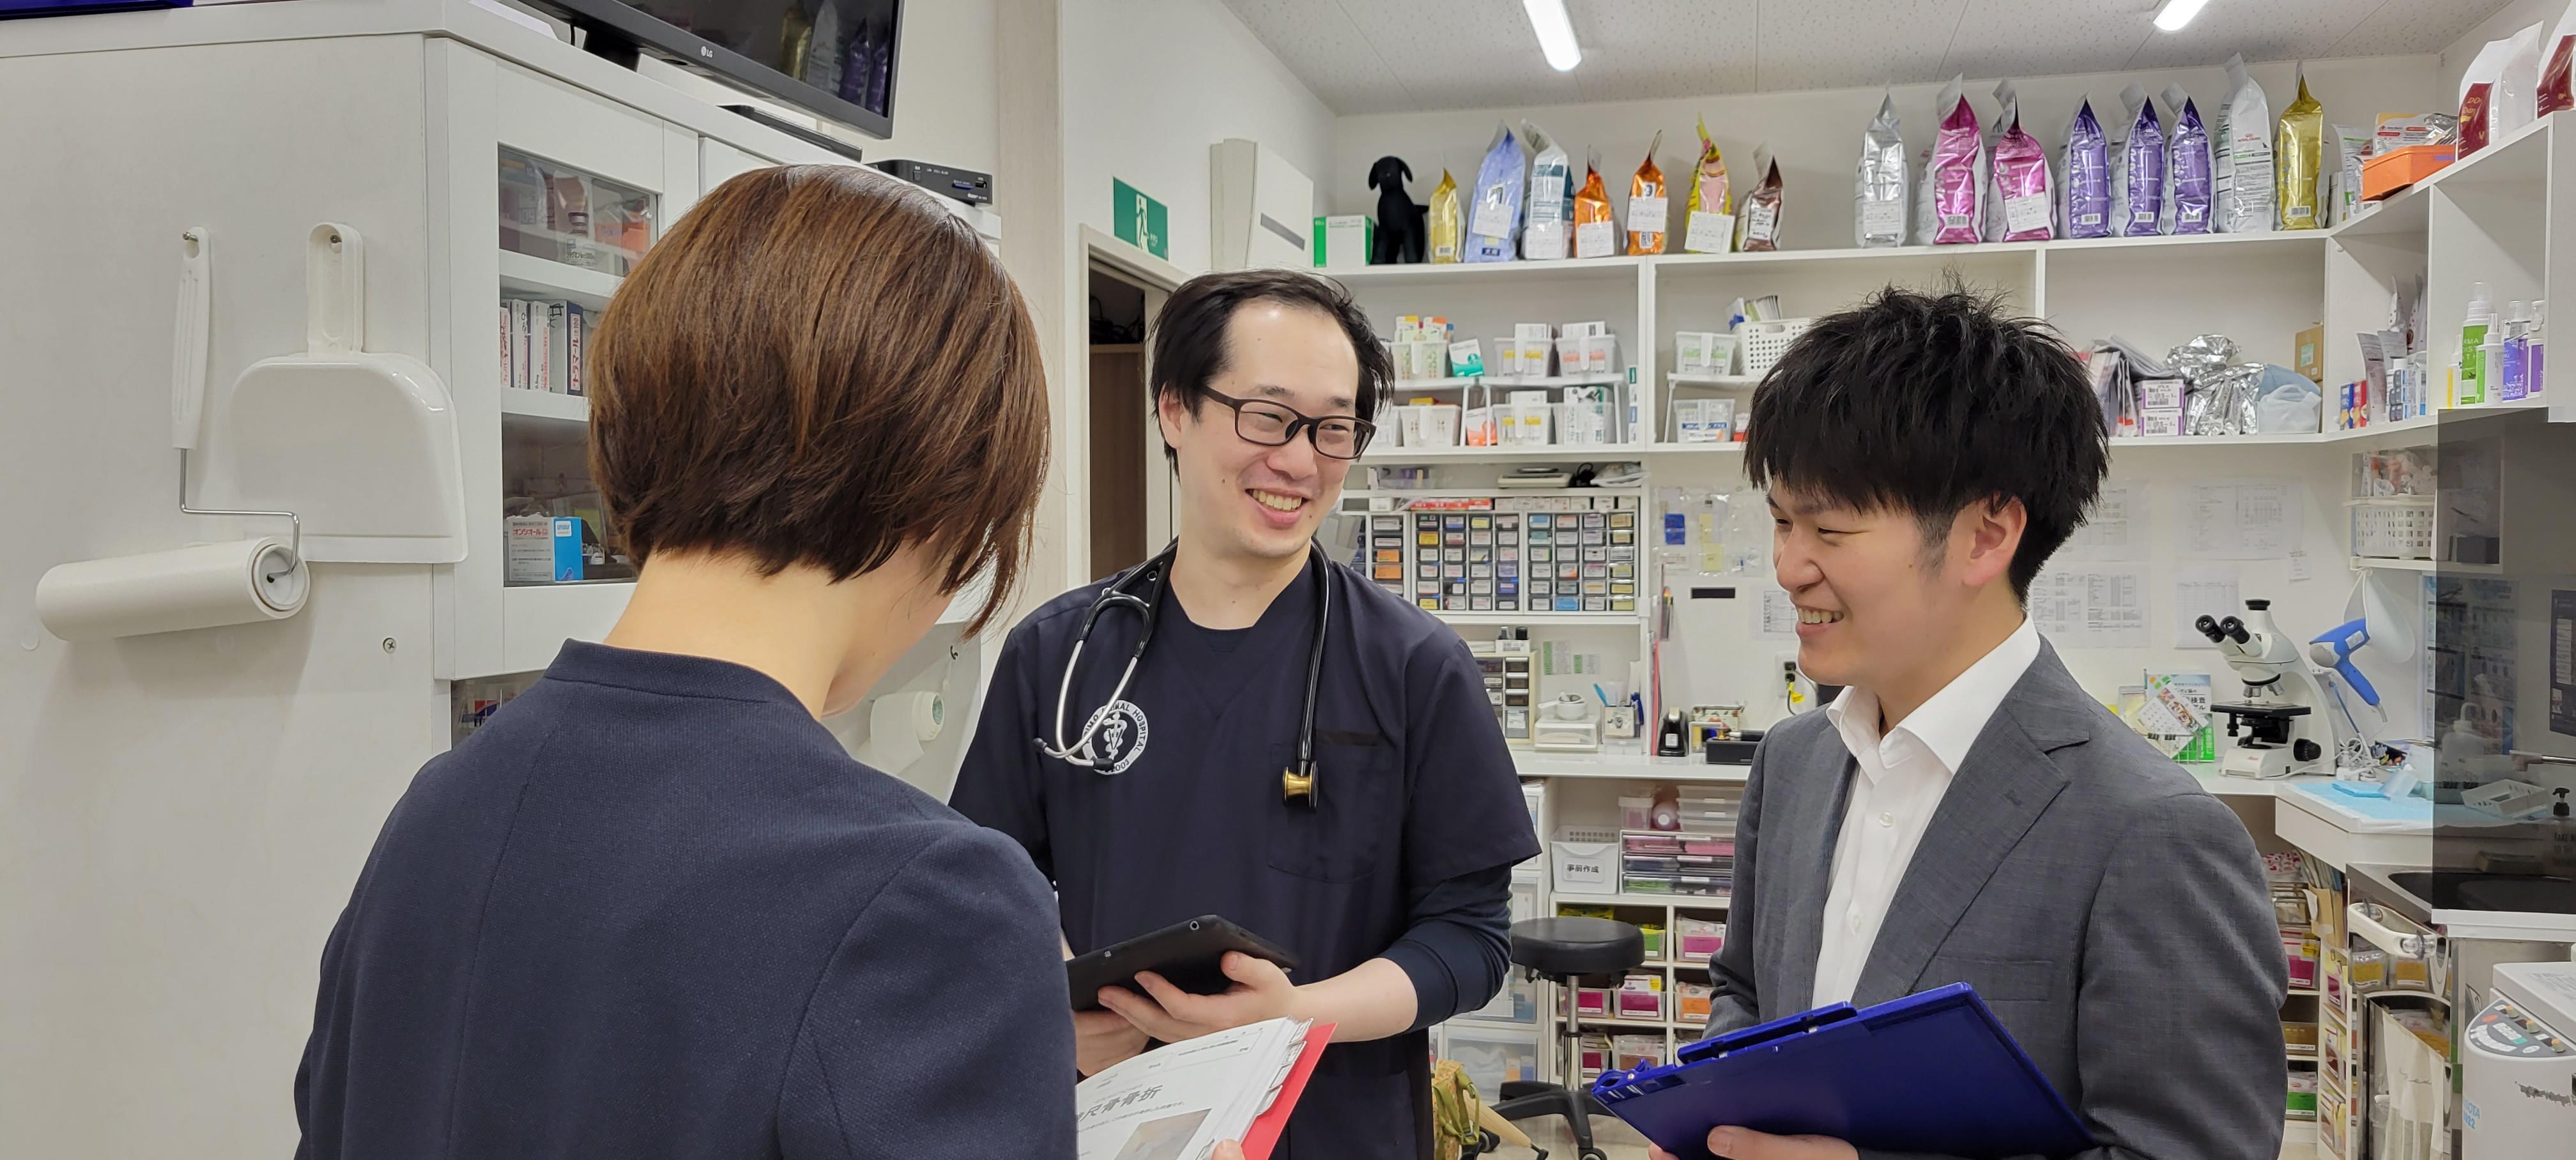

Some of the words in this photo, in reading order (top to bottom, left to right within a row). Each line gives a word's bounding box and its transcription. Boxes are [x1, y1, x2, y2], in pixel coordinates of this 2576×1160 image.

[706, 49, 713, 58] LG
[1567, 864, 1600, 874] 事前作成
